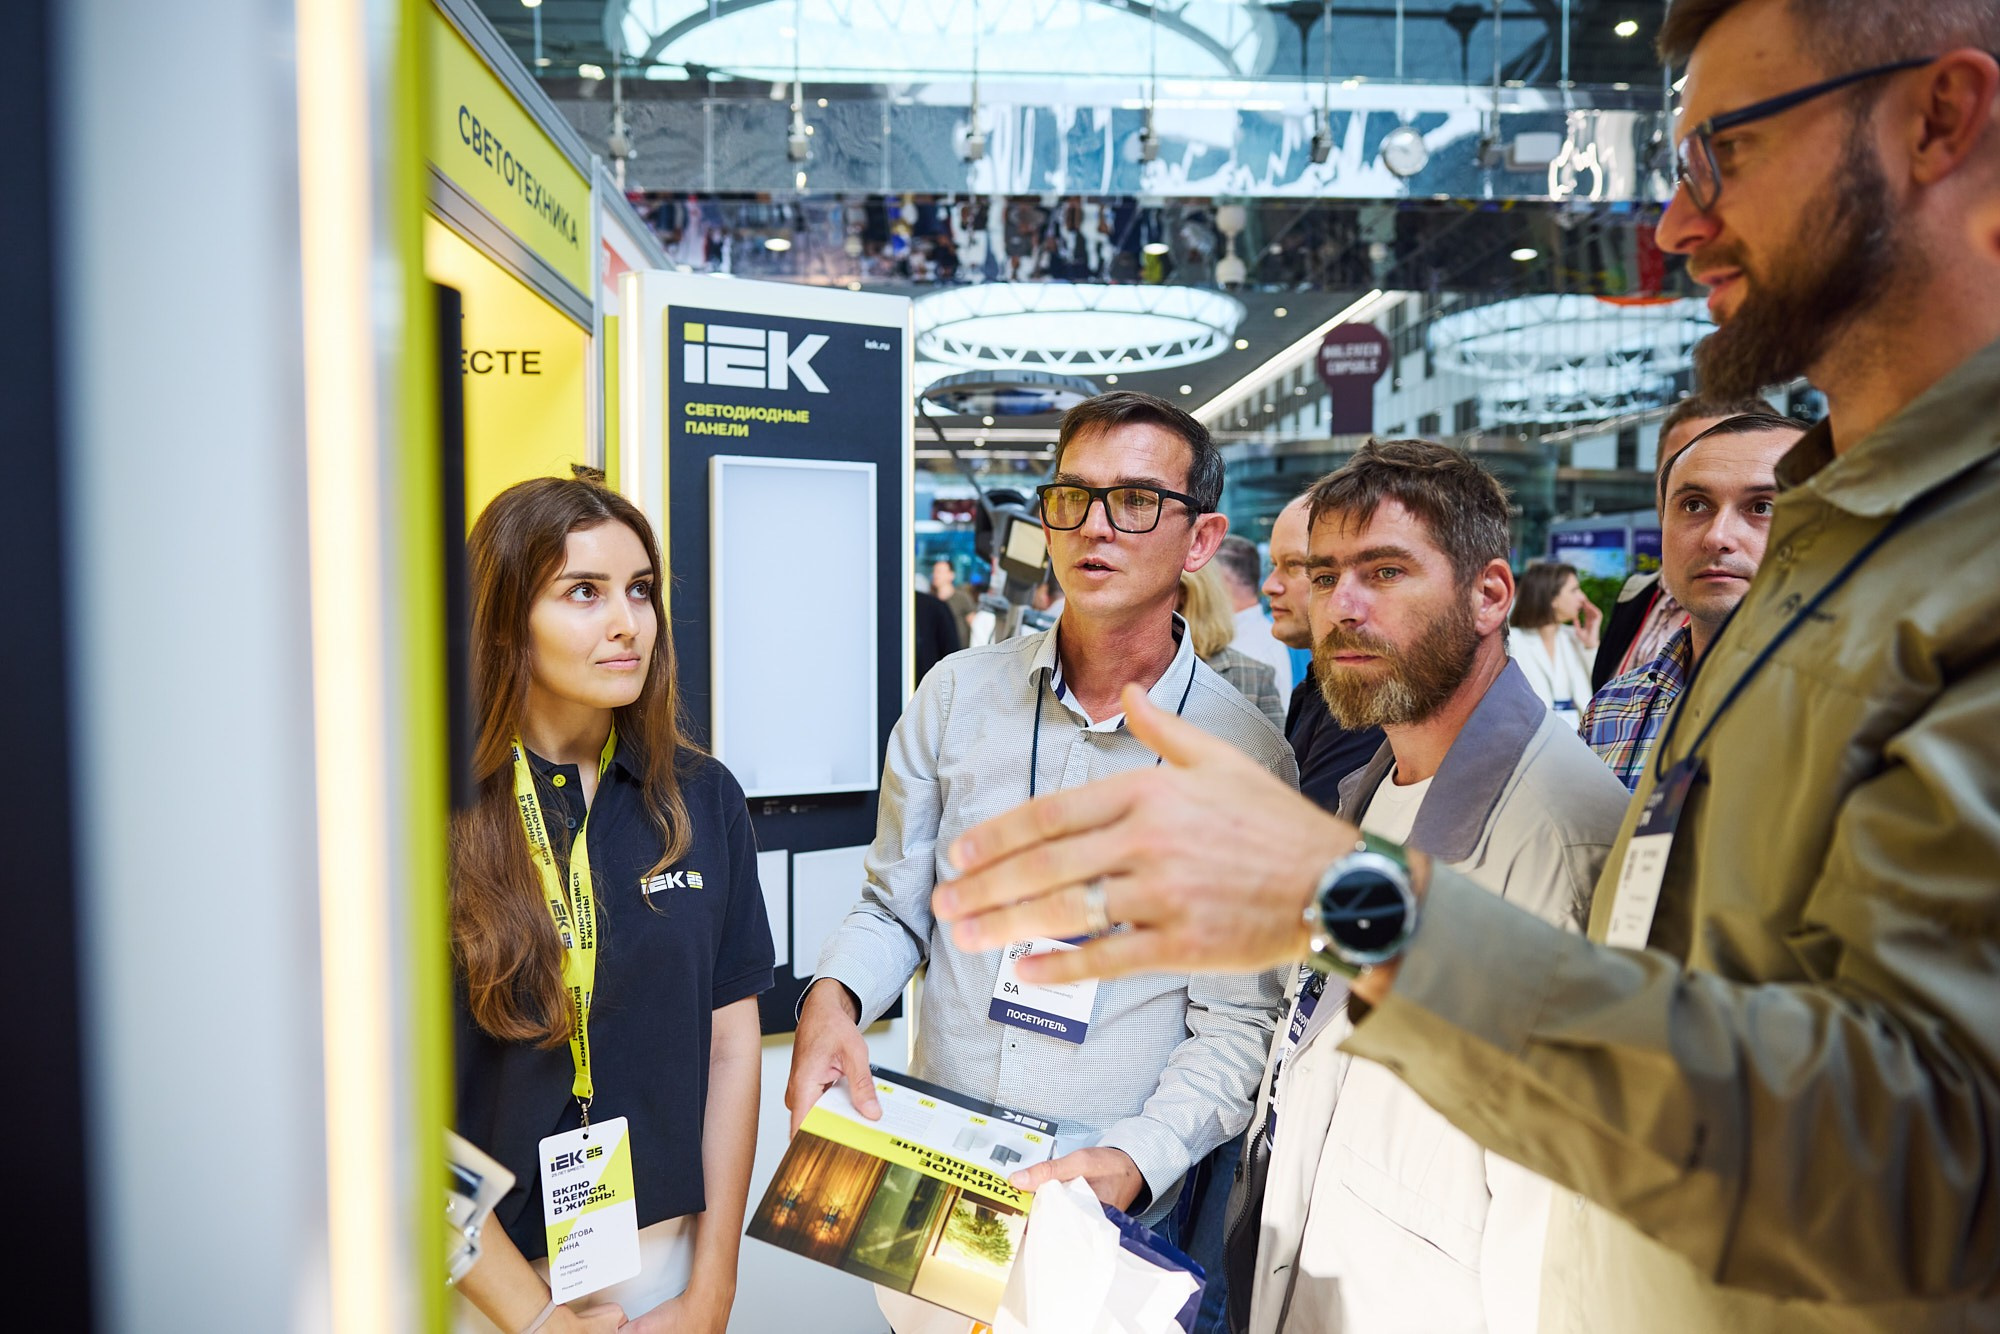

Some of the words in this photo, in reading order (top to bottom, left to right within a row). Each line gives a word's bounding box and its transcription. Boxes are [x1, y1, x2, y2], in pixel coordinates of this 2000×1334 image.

[459, 105, 579, 250] СВЕТОТЕХНИКА
[685, 402, 810, 424] СВЕТОДИОДНЫЕ
[685, 421, 749, 437] ПАНЕЛИ
[521, 803, 538, 845] ЖИЗНЬ!
[526, 794, 551, 865] ВКЛЮЧАЕМСЯ
[573, 872, 587, 950] ВКЛЮЧАЕМСЯ
[583, 895, 593, 940] ЖИЗНЬ!
[1003, 982, 1020, 995] SA
[574, 986, 586, 1067] ВКЛЮЧАЕМСЯ
[1006, 1009, 1067, 1033] ПОСЕТИТЕЛЬ
[586, 1146, 603, 1159] 25
[889, 1137, 1022, 1195] ОСВЕЩЕНИЕ
[552, 1180, 590, 1197] ВКЛЮ
[918, 1157, 1020, 1203] УЛИЧНОЕ
[553, 1184, 606, 1204] ЧАЕМСЯ
[554, 1207, 562, 1215] В
[566, 1190, 615, 1211] ЖИЗНЬ!
[557, 1227, 594, 1245] ДОЛГОВА
[558, 1241, 580, 1253] АННА
